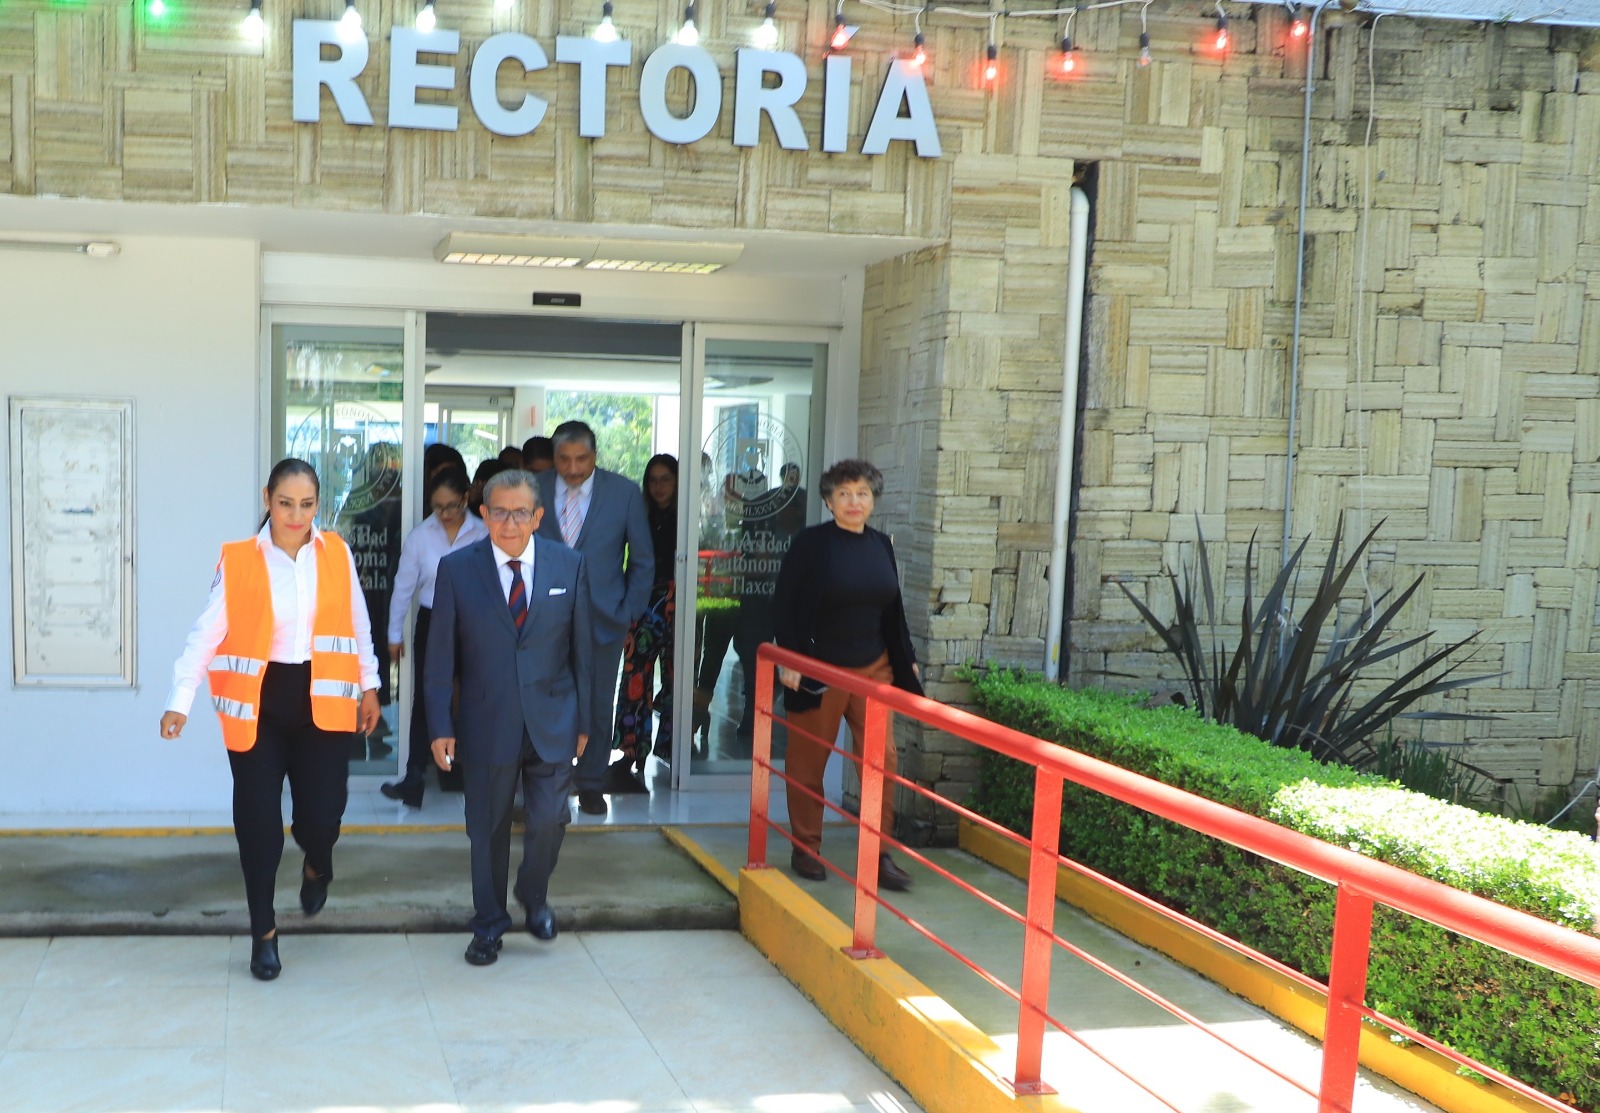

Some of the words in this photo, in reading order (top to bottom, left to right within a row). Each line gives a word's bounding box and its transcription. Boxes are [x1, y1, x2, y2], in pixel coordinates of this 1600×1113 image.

[292, 19, 942, 158] RECTORÍA
[712, 553, 782, 574] utónom
[730, 576, 776, 596] Tlaxca
